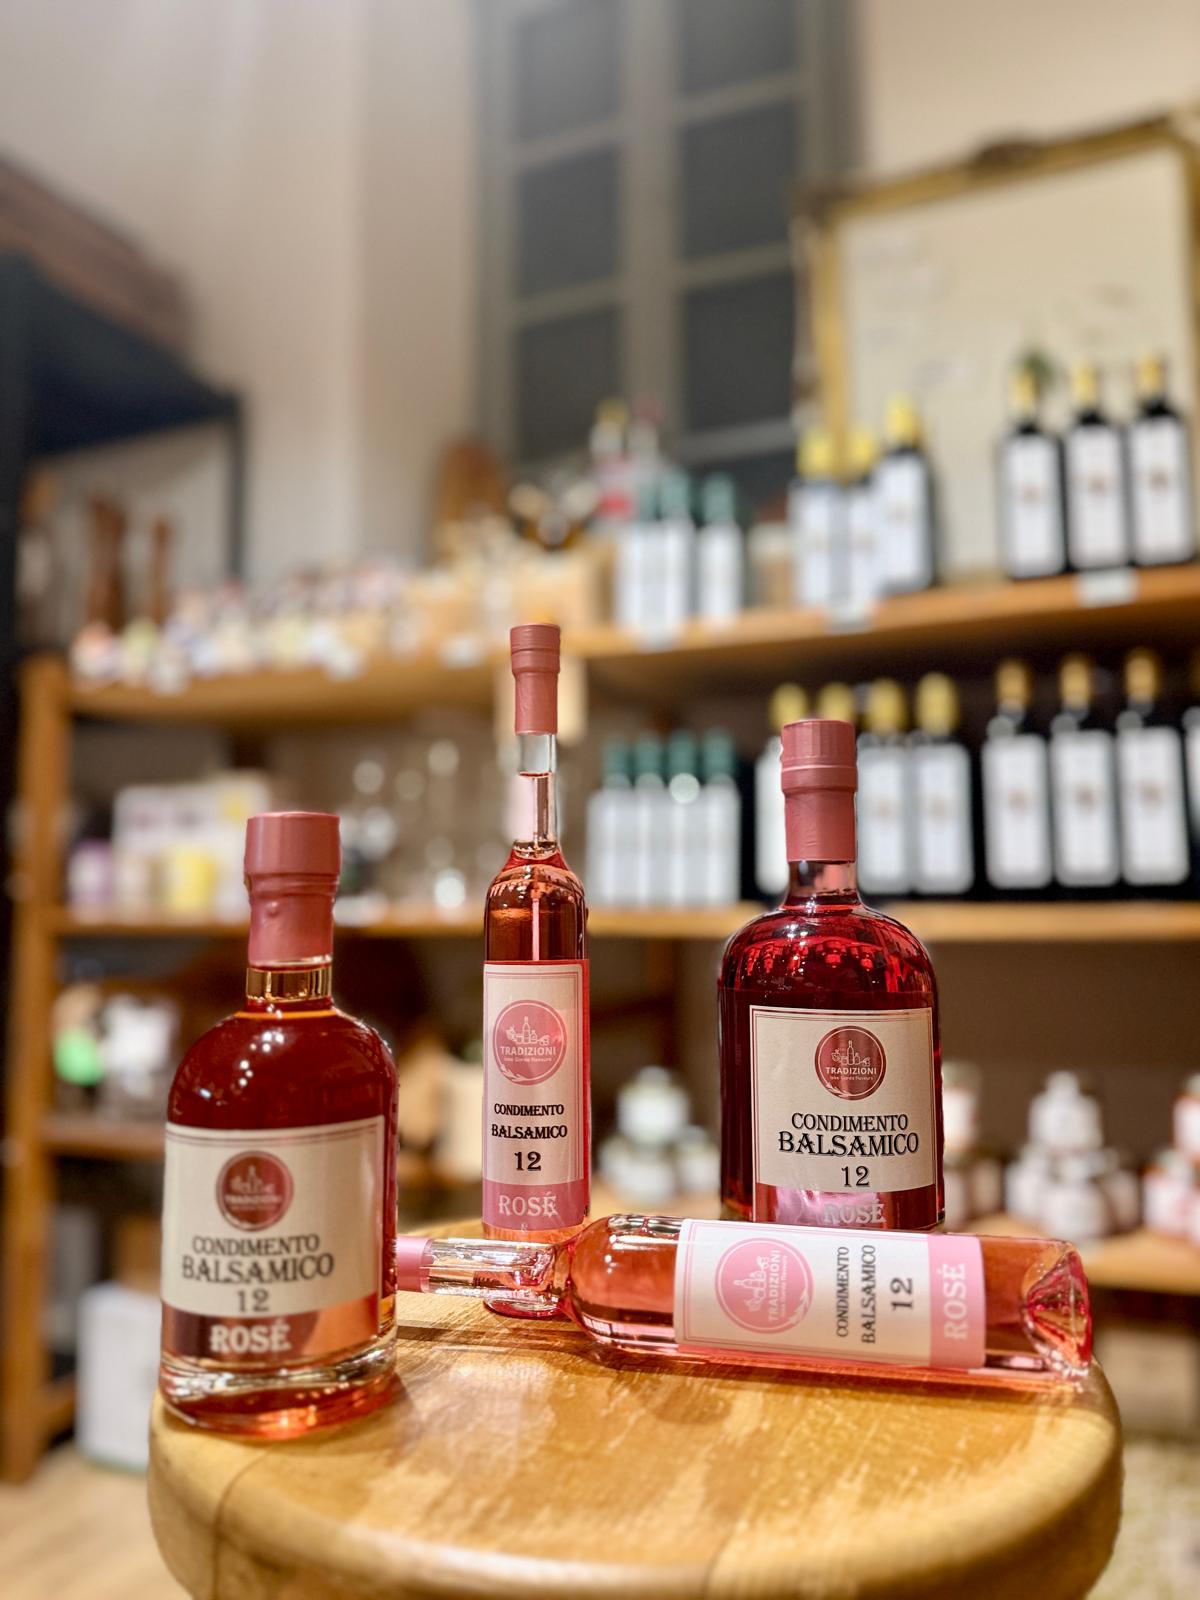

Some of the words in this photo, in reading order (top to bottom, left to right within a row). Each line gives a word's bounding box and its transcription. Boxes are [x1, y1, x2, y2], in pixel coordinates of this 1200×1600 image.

[500, 1046, 556, 1056] TRADIZIONI
[825, 1066, 877, 1075] TRADIZIONI
[494, 1103, 564, 1116] CONDIMENTO
[791, 1112, 908, 1132] CONDIMENTO
[491, 1124, 568, 1139] BALSAMICO
[778, 1131, 920, 1157] BALSAMICO
[514, 1151, 541, 1171] 12
[841, 1165, 870, 1187] 12
[498, 1191, 558, 1217] ROSÉ
[823, 1199, 886, 1225] ROSÉ
[192, 1234, 319, 1256] CONDIMENTO
[181, 1252, 334, 1284] BALSAMICO
[768, 1249, 780, 1321] TRADIZIONI
[836, 1246, 849, 1337] CONDIMENTO
[861, 1245, 875, 1344] BALSAMICO
[890, 1277, 913, 1310] 12
[237, 1289, 269, 1312] 12
[937, 1263, 968, 1341] ROSÉ
[210, 1318, 291, 1353] ROSÉ
